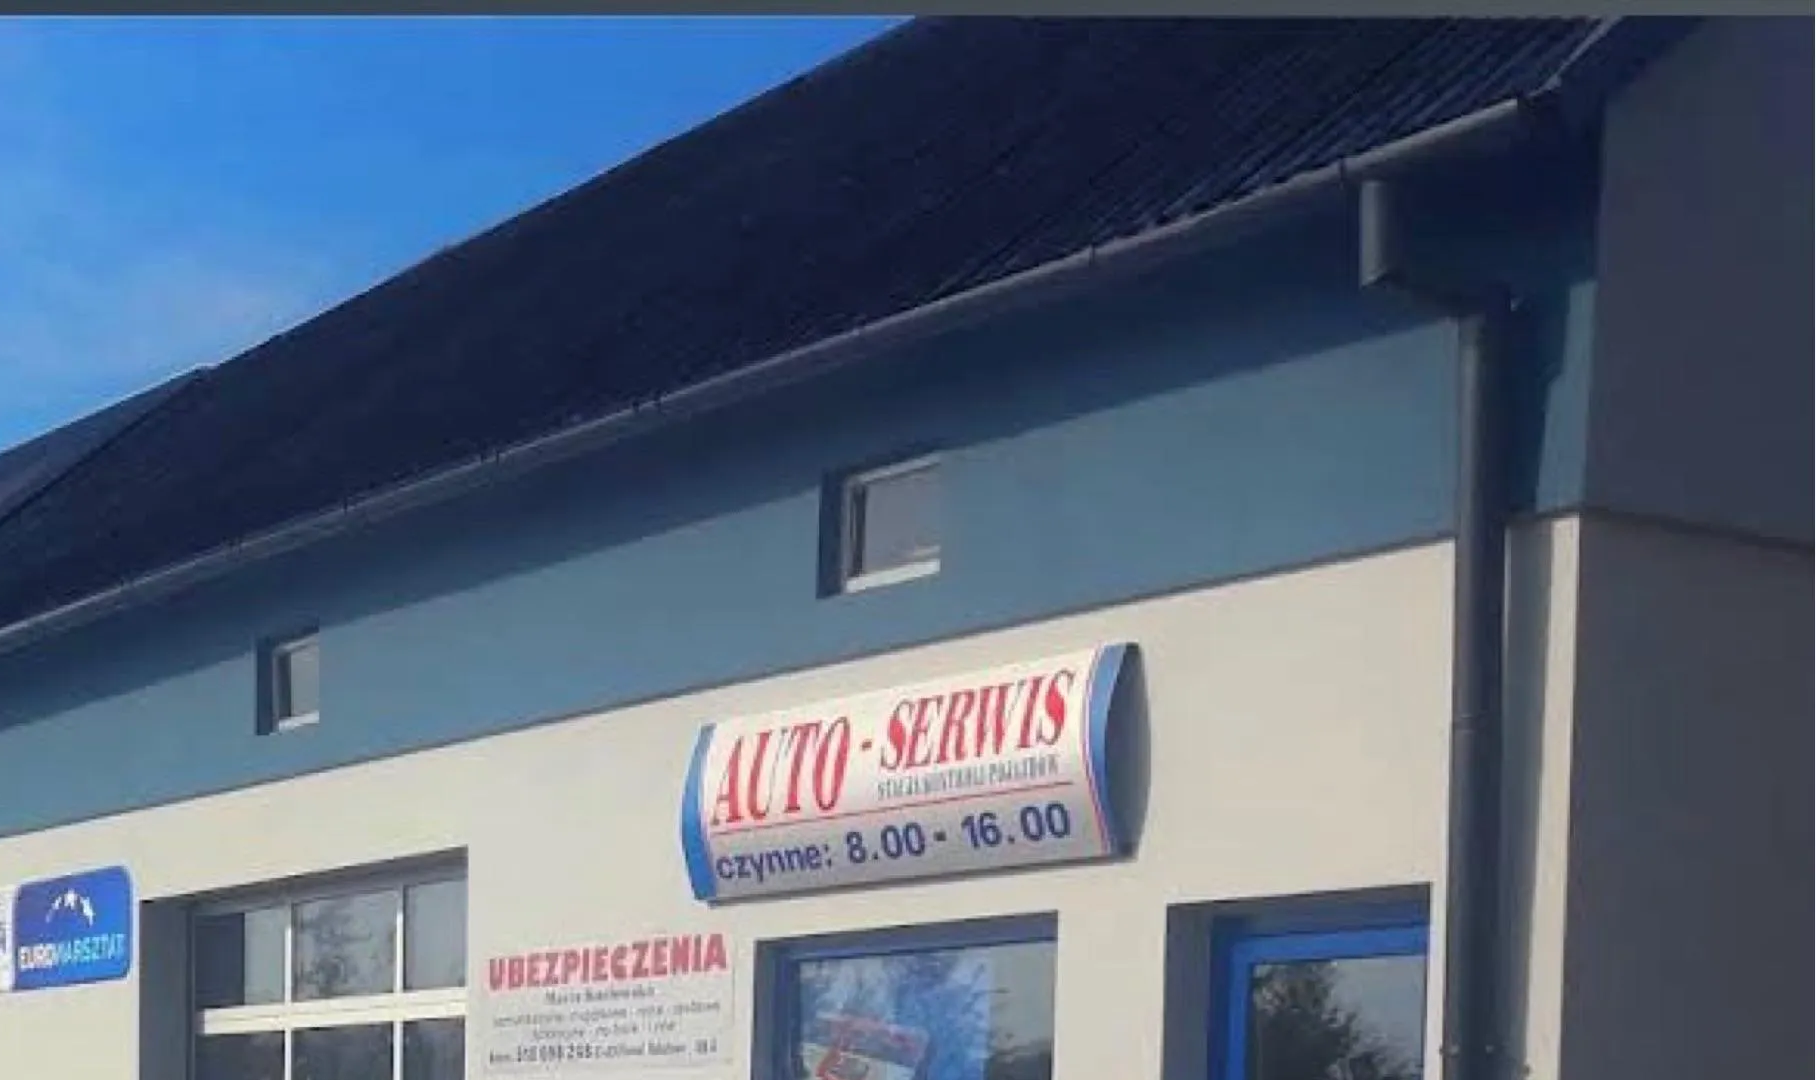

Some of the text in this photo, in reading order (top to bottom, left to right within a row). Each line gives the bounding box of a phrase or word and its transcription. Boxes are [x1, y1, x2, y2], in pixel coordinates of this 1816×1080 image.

[710, 716, 851, 826] AUTO
[878, 668, 1077, 772] SERWIS
[716, 840, 834, 884] czynne:
[845, 821, 927, 865] 8.00
[960, 802, 1071, 850] 16.00
[489, 933, 727, 991] UBEZPIECZENIA
